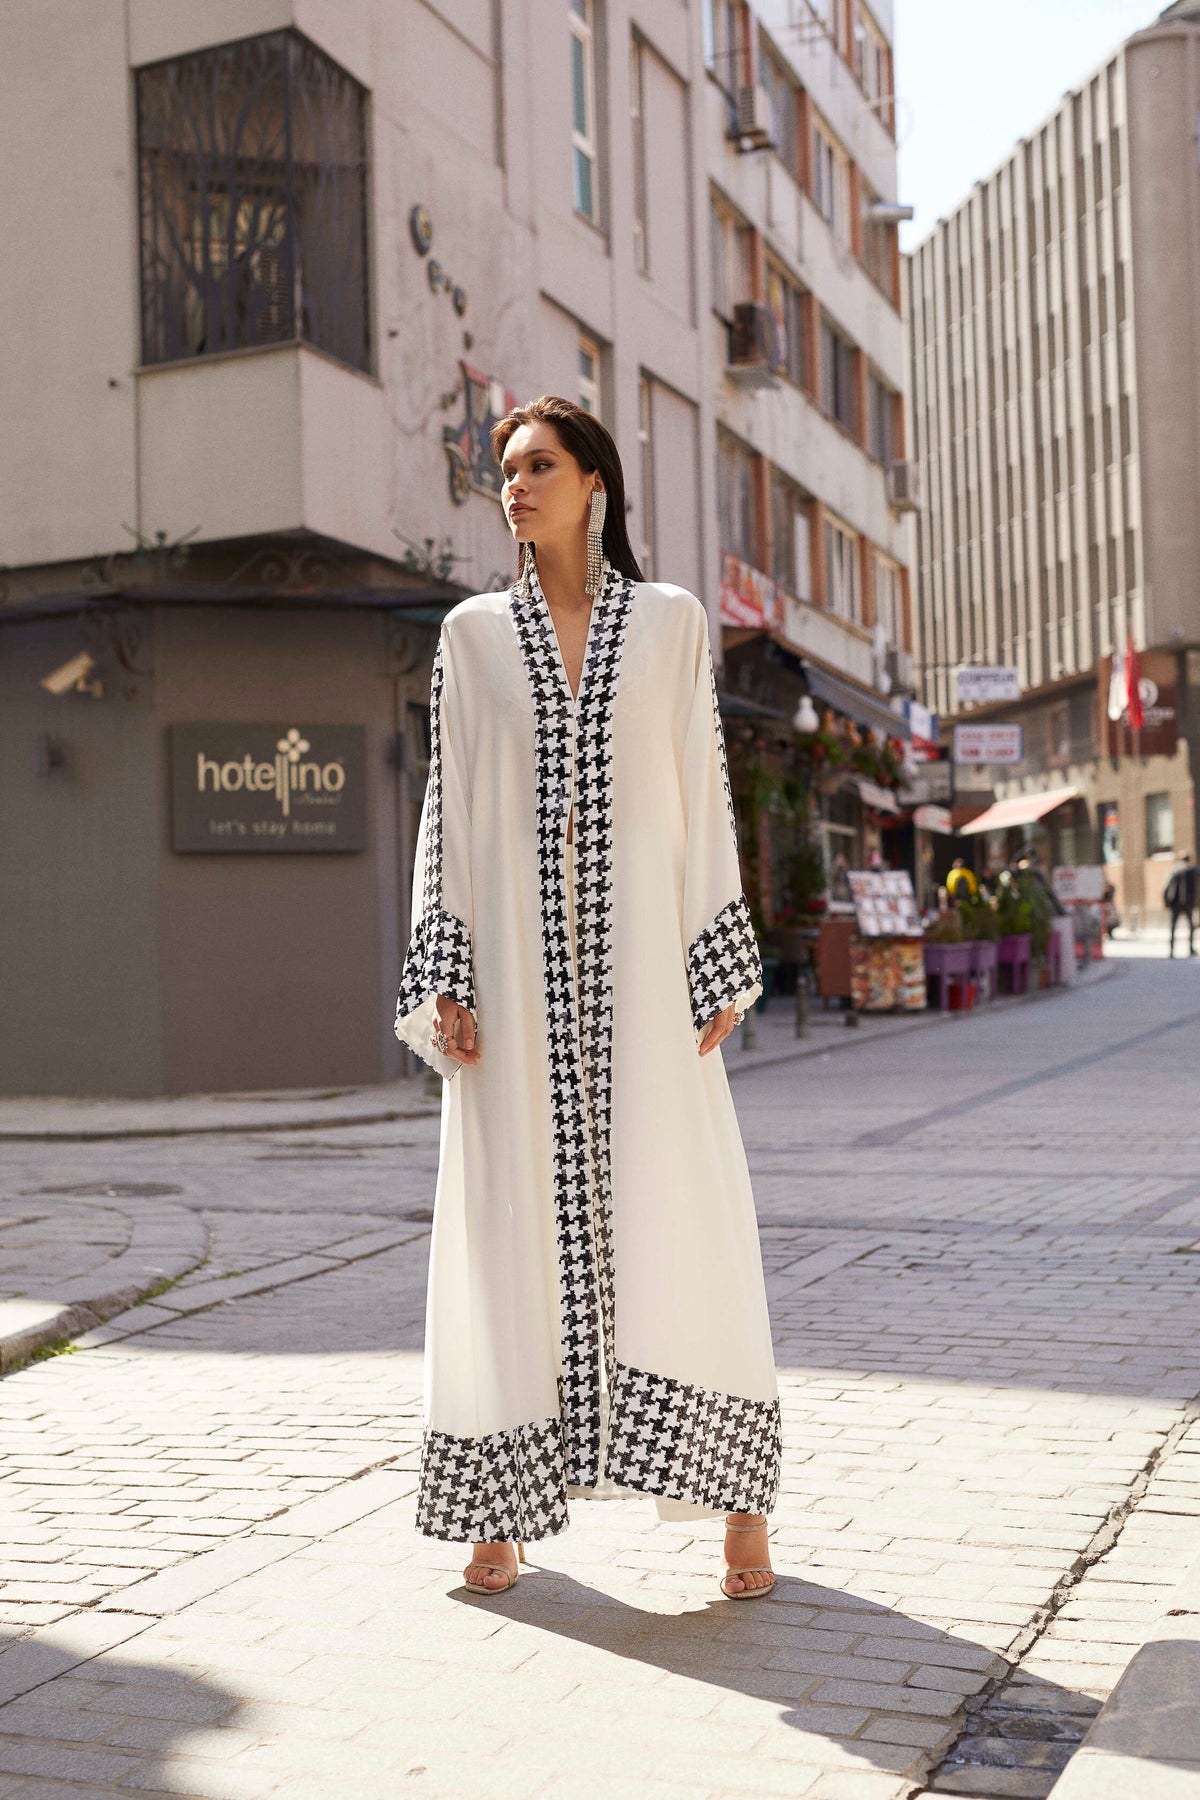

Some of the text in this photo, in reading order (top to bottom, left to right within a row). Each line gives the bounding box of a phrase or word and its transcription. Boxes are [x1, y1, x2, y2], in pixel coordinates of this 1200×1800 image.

[197, 752, 345, 816] hotellino
[210, 819, 336, 838] let's stay home
